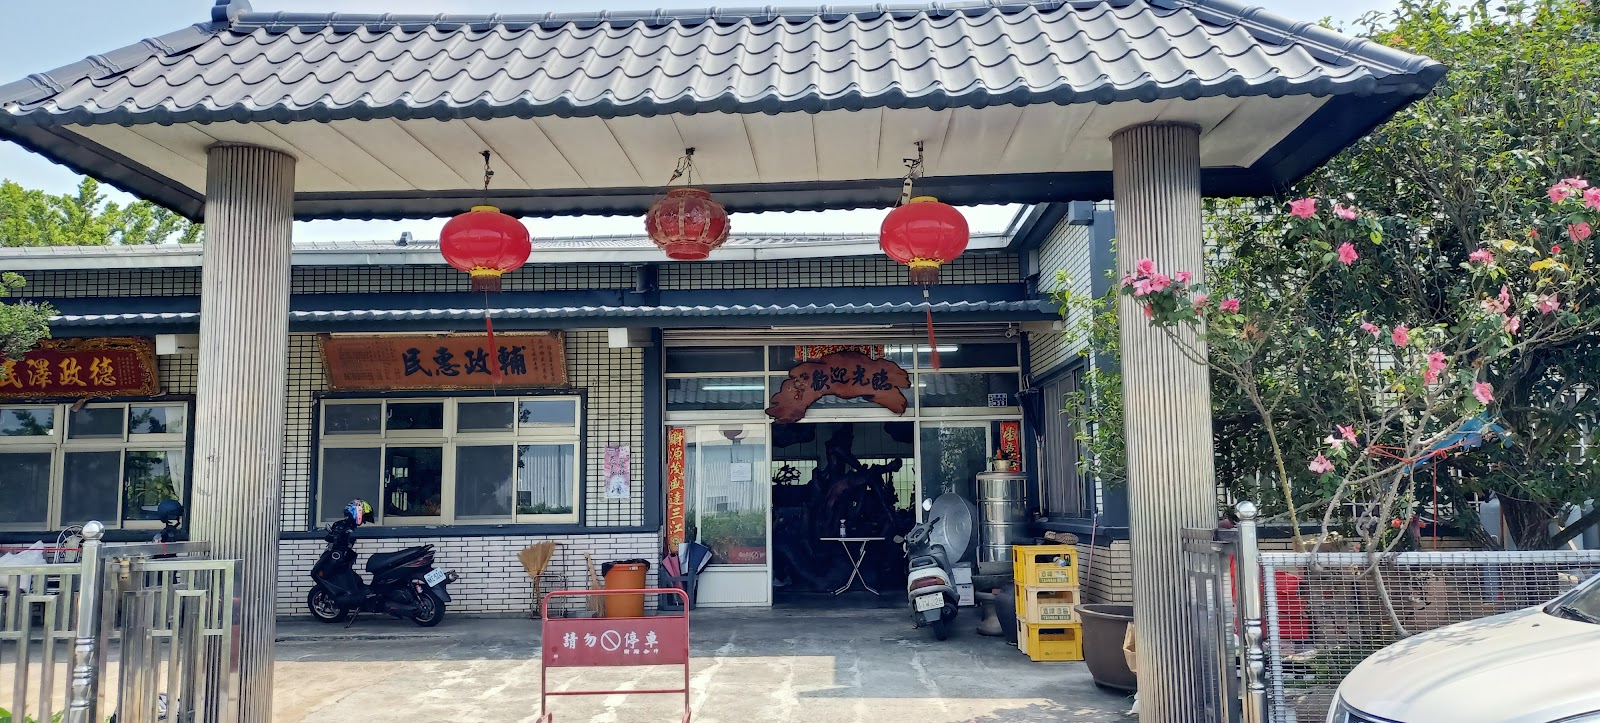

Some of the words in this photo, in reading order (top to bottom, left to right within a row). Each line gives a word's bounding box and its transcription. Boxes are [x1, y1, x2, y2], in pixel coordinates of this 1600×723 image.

[811, 365, 893, 391] 歡迎光臨
[563, 631, 597, 649] 請勿
[624, 631, 659, 649] 停車
